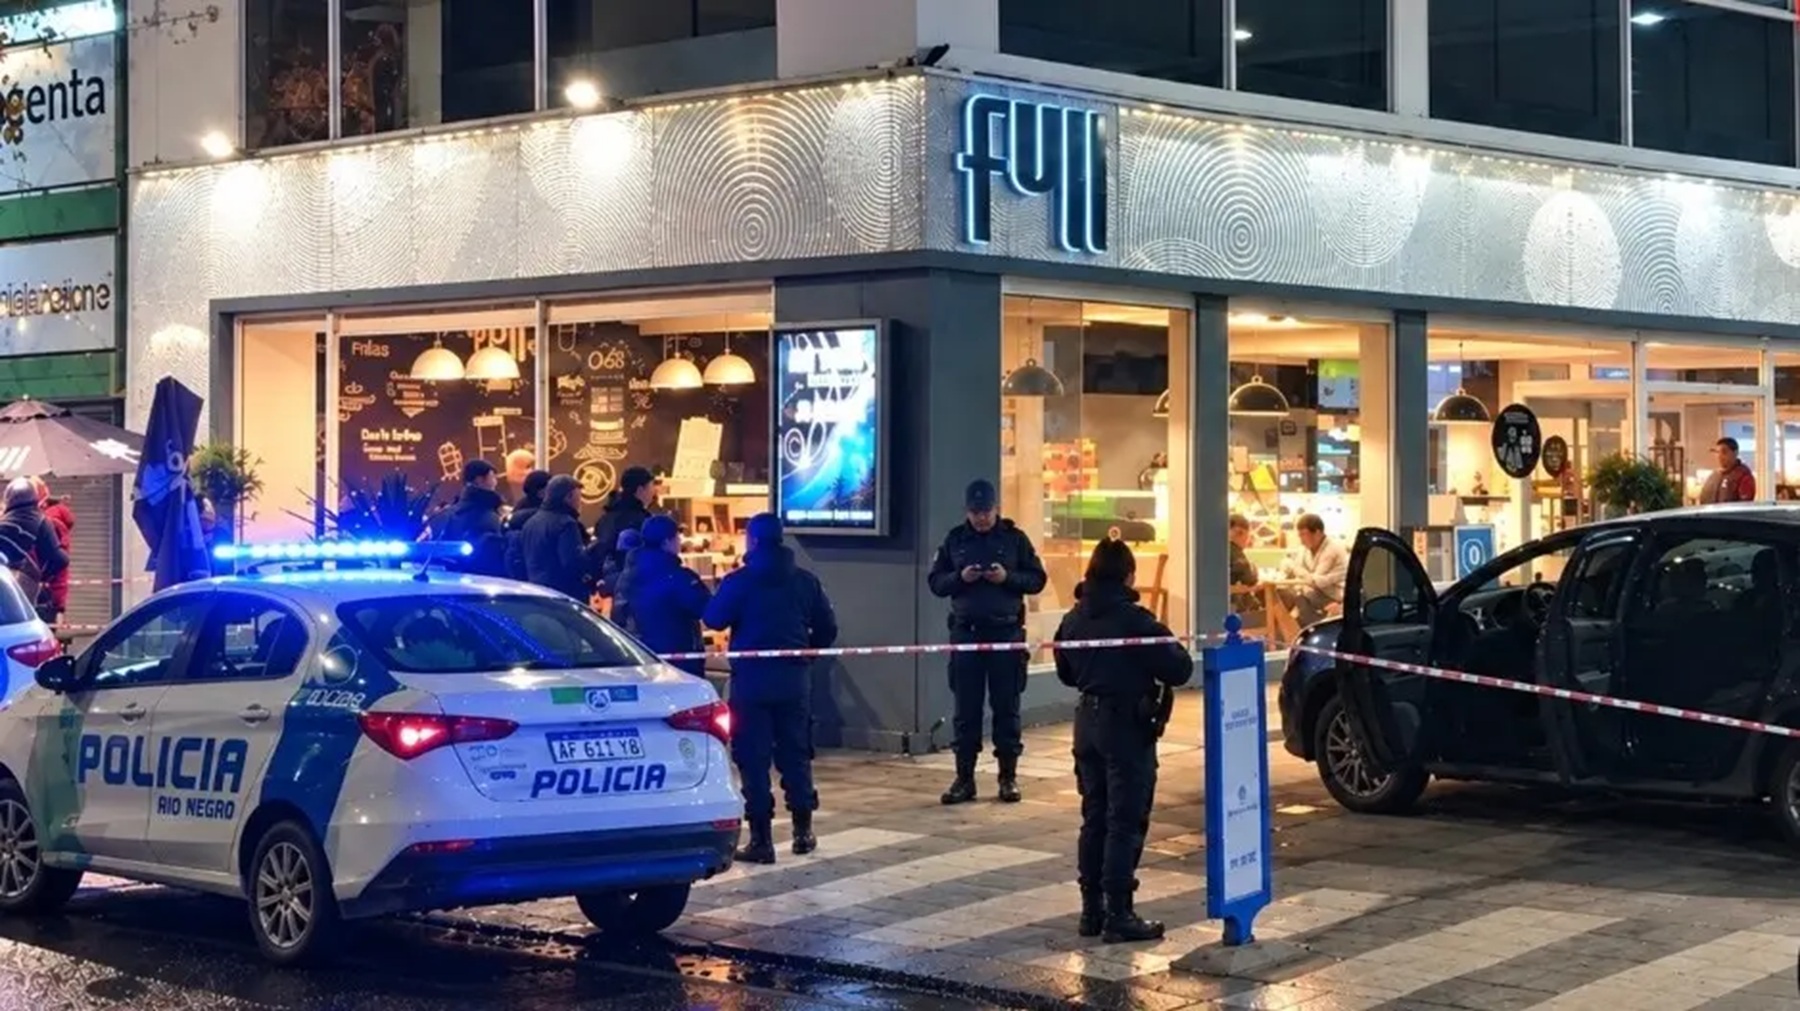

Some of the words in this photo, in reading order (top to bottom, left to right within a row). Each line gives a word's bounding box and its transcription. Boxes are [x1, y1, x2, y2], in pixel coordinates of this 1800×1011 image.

[78, 734, 249, 793] POLICIA
[560, 742, 576, 759] AF
[584, 740, 615, 758] 611
[530, 763, 667, 799] POLICIA
[157, 795, 181, 815] RIO
[186, 798, 235, 820] NEGRO
